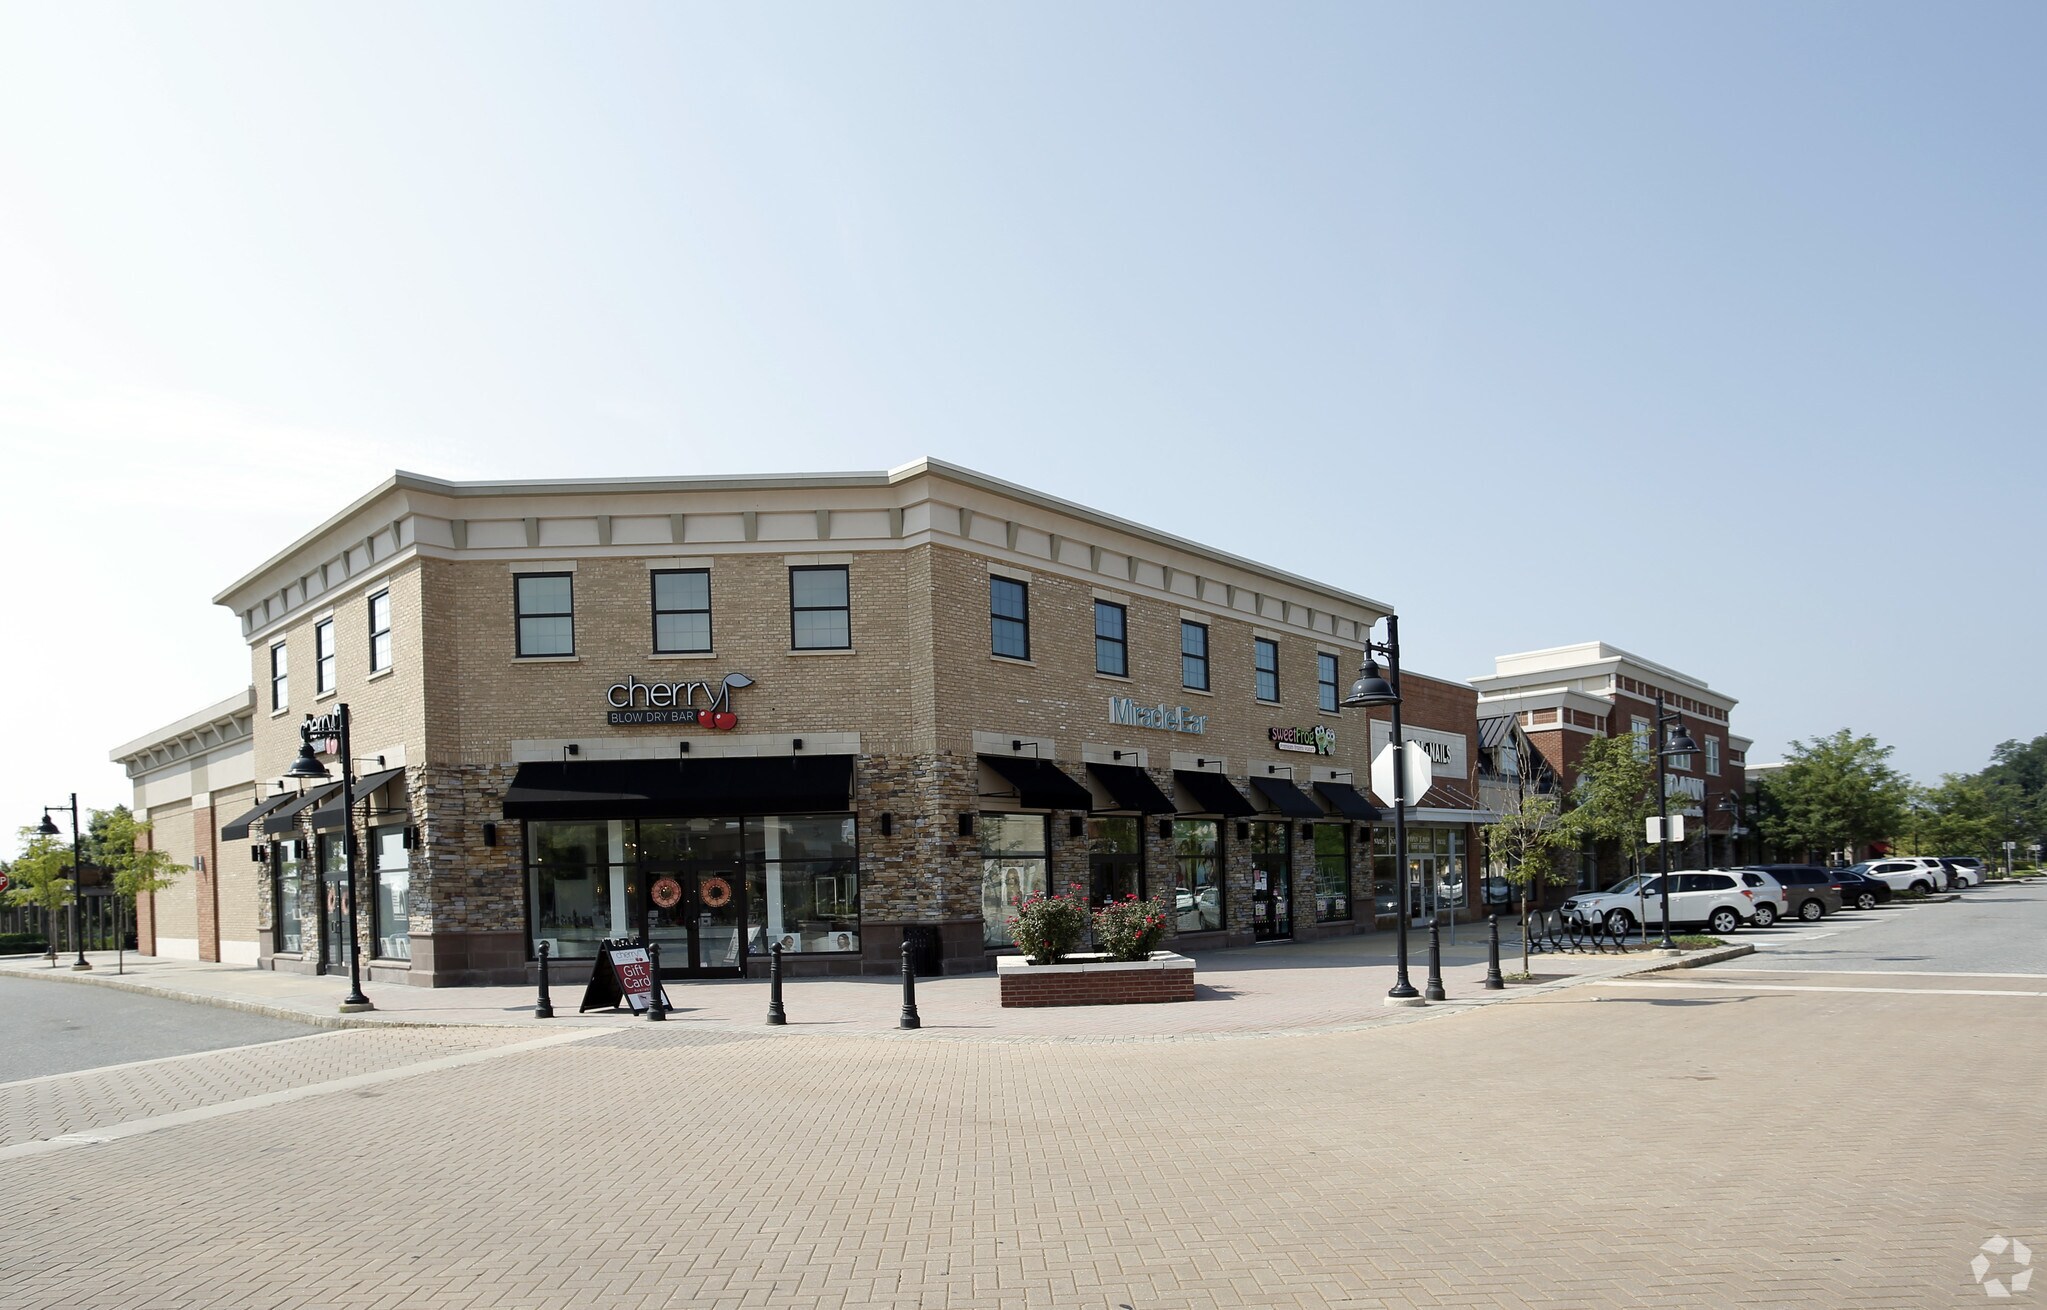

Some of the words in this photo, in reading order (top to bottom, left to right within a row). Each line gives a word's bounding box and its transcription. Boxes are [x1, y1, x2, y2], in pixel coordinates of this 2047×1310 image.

[607, 674, 726, 711] cherry
[611, 712, 644, 723] BLOW
[646, 711, 668, 722] DRY
[671, 711, 694, 721] BAR
[1430, 742, 1452, 764] NAILS
[623, 964, 645, 977] Gift
[623, 975, 651, 988] Card
